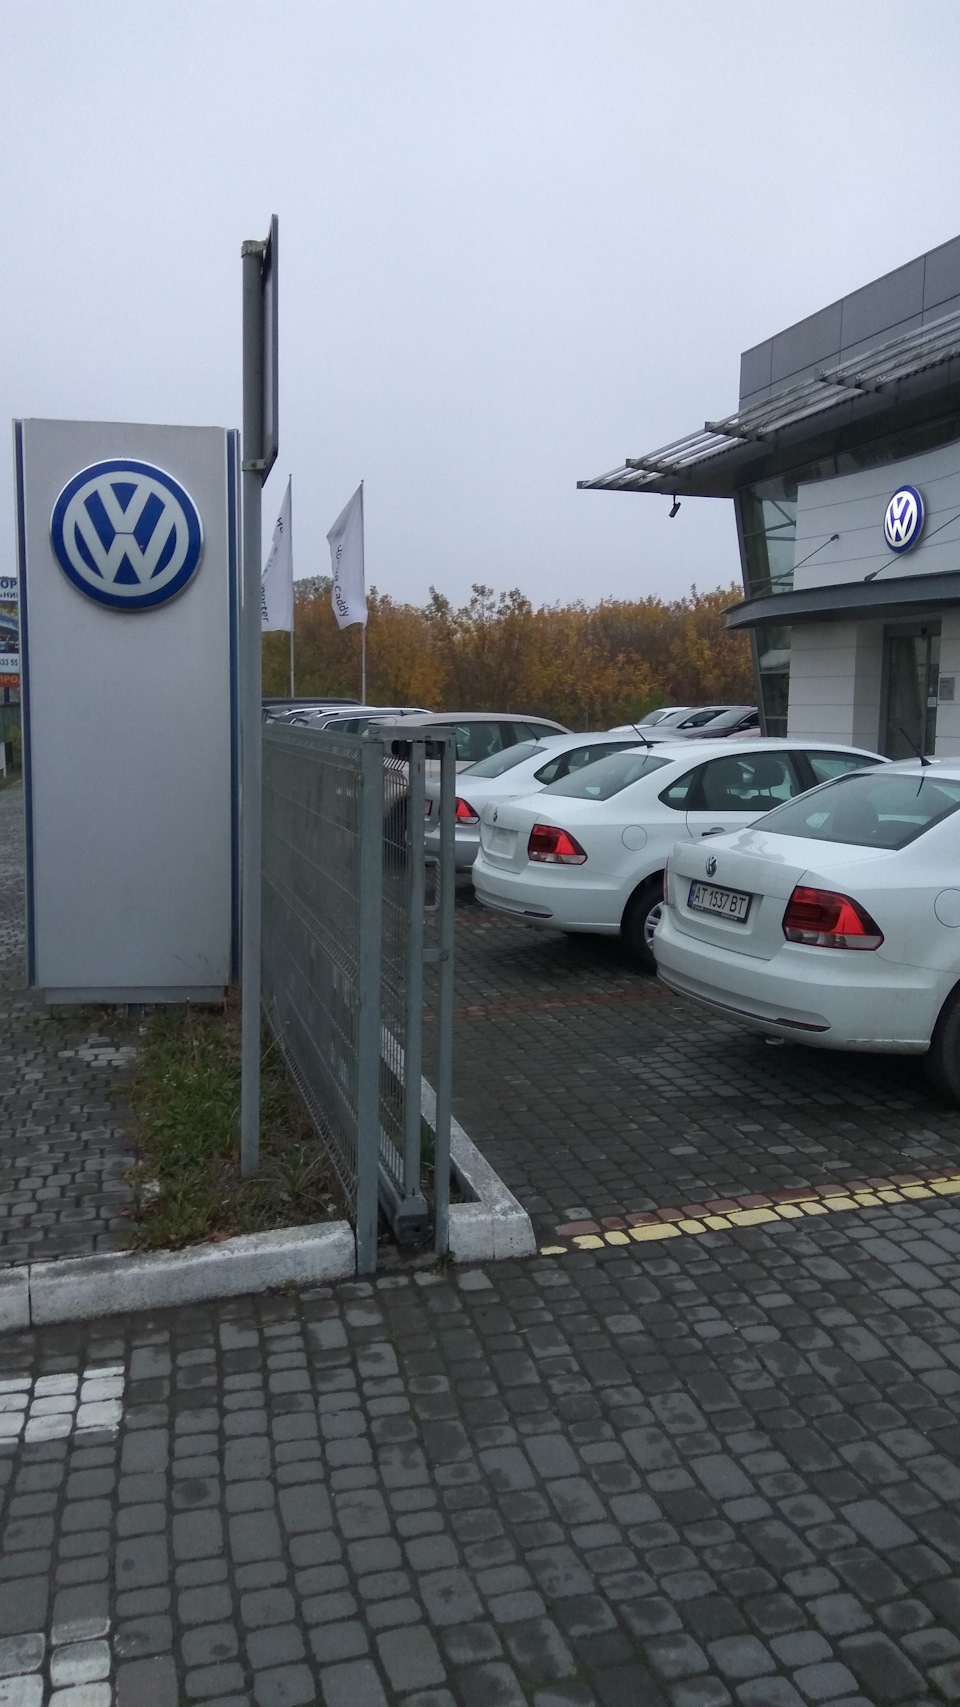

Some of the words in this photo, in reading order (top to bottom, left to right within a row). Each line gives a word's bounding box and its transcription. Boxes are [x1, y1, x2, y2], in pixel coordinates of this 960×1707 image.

[334, 585, 349, 618] Caddy
[694, 887, 707, 904] AT
[709, 890, 730, 910] 1537
[729, 895, 746, 914] BT
